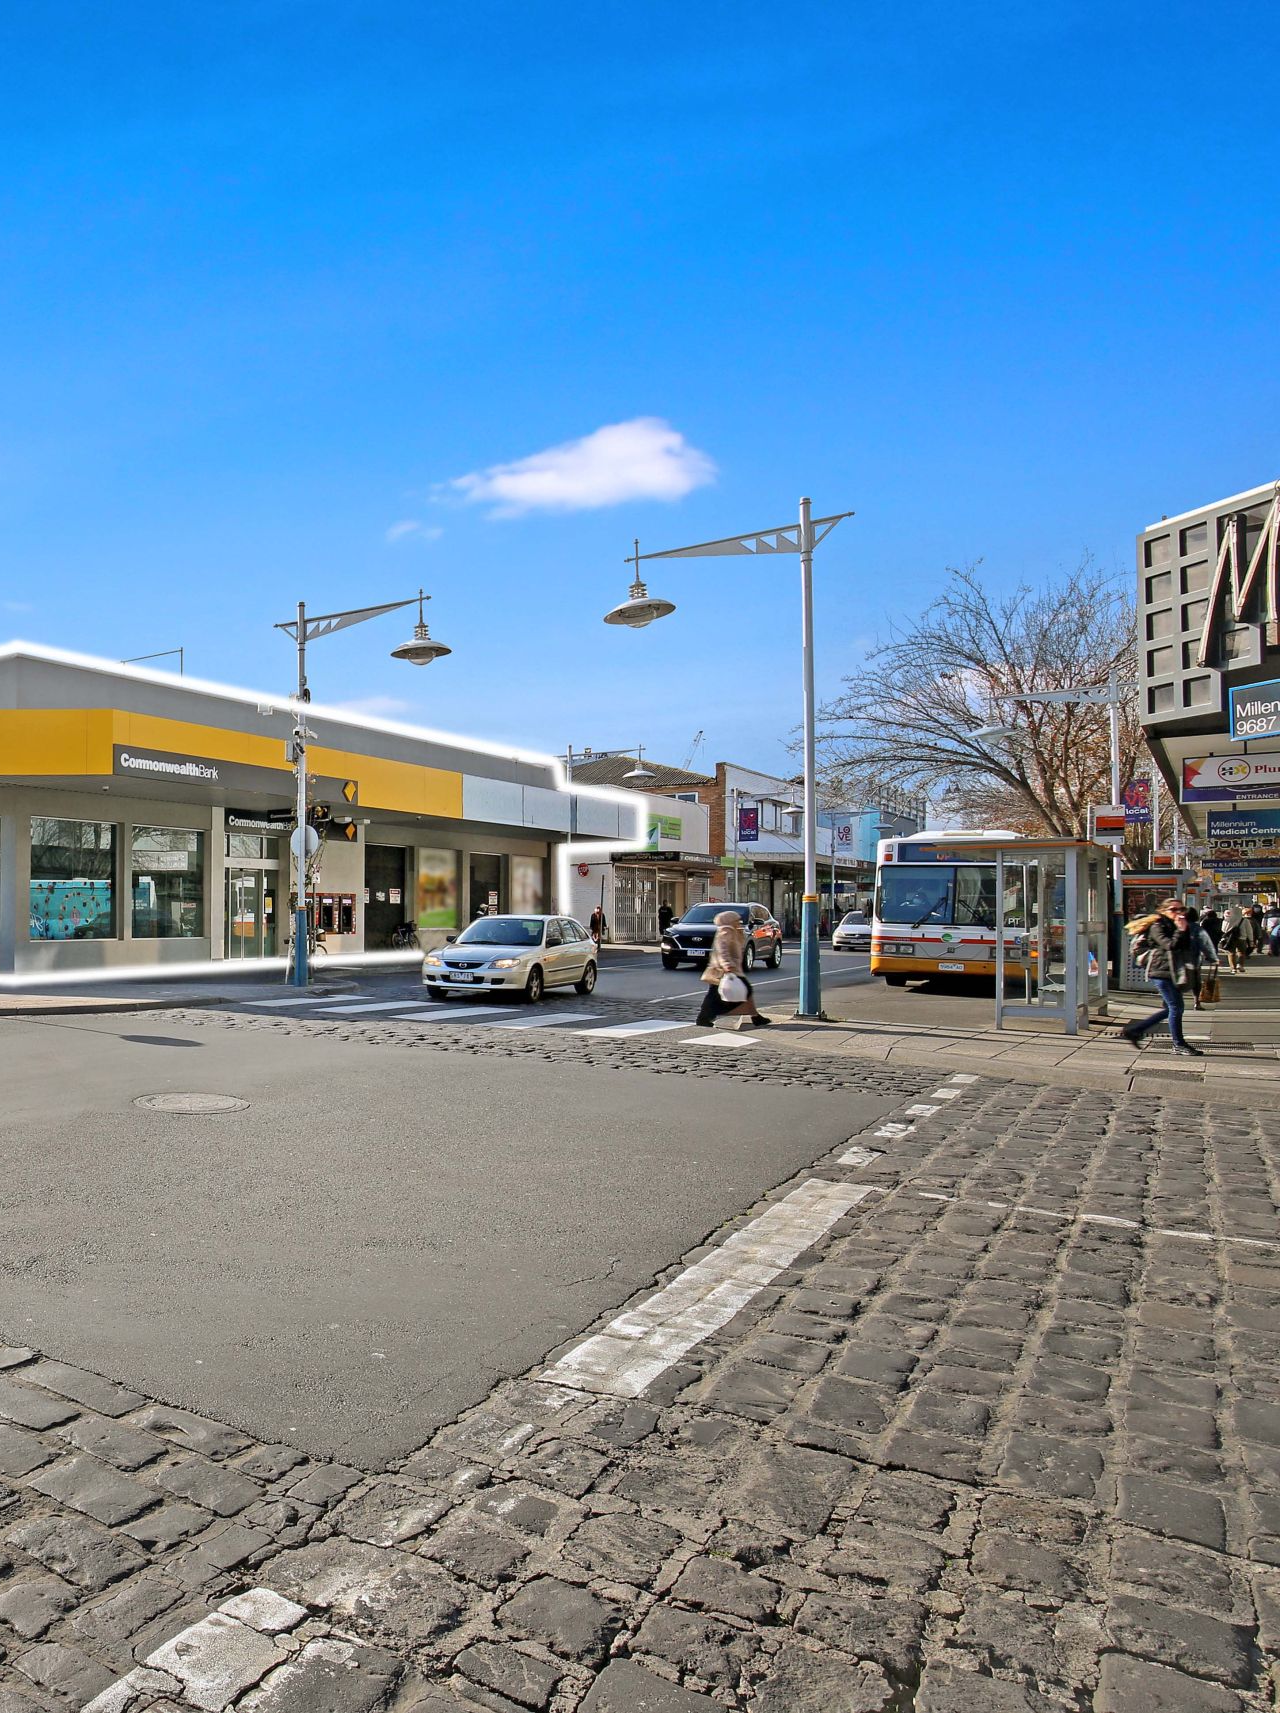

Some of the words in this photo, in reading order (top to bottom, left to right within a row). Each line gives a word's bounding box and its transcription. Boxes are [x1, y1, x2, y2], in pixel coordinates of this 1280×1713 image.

[1236, 716, 1277, 735] 9687
[120, 752, 219, 779] CommonwealthBank
[1211, 828, 1249, 836] Medical
